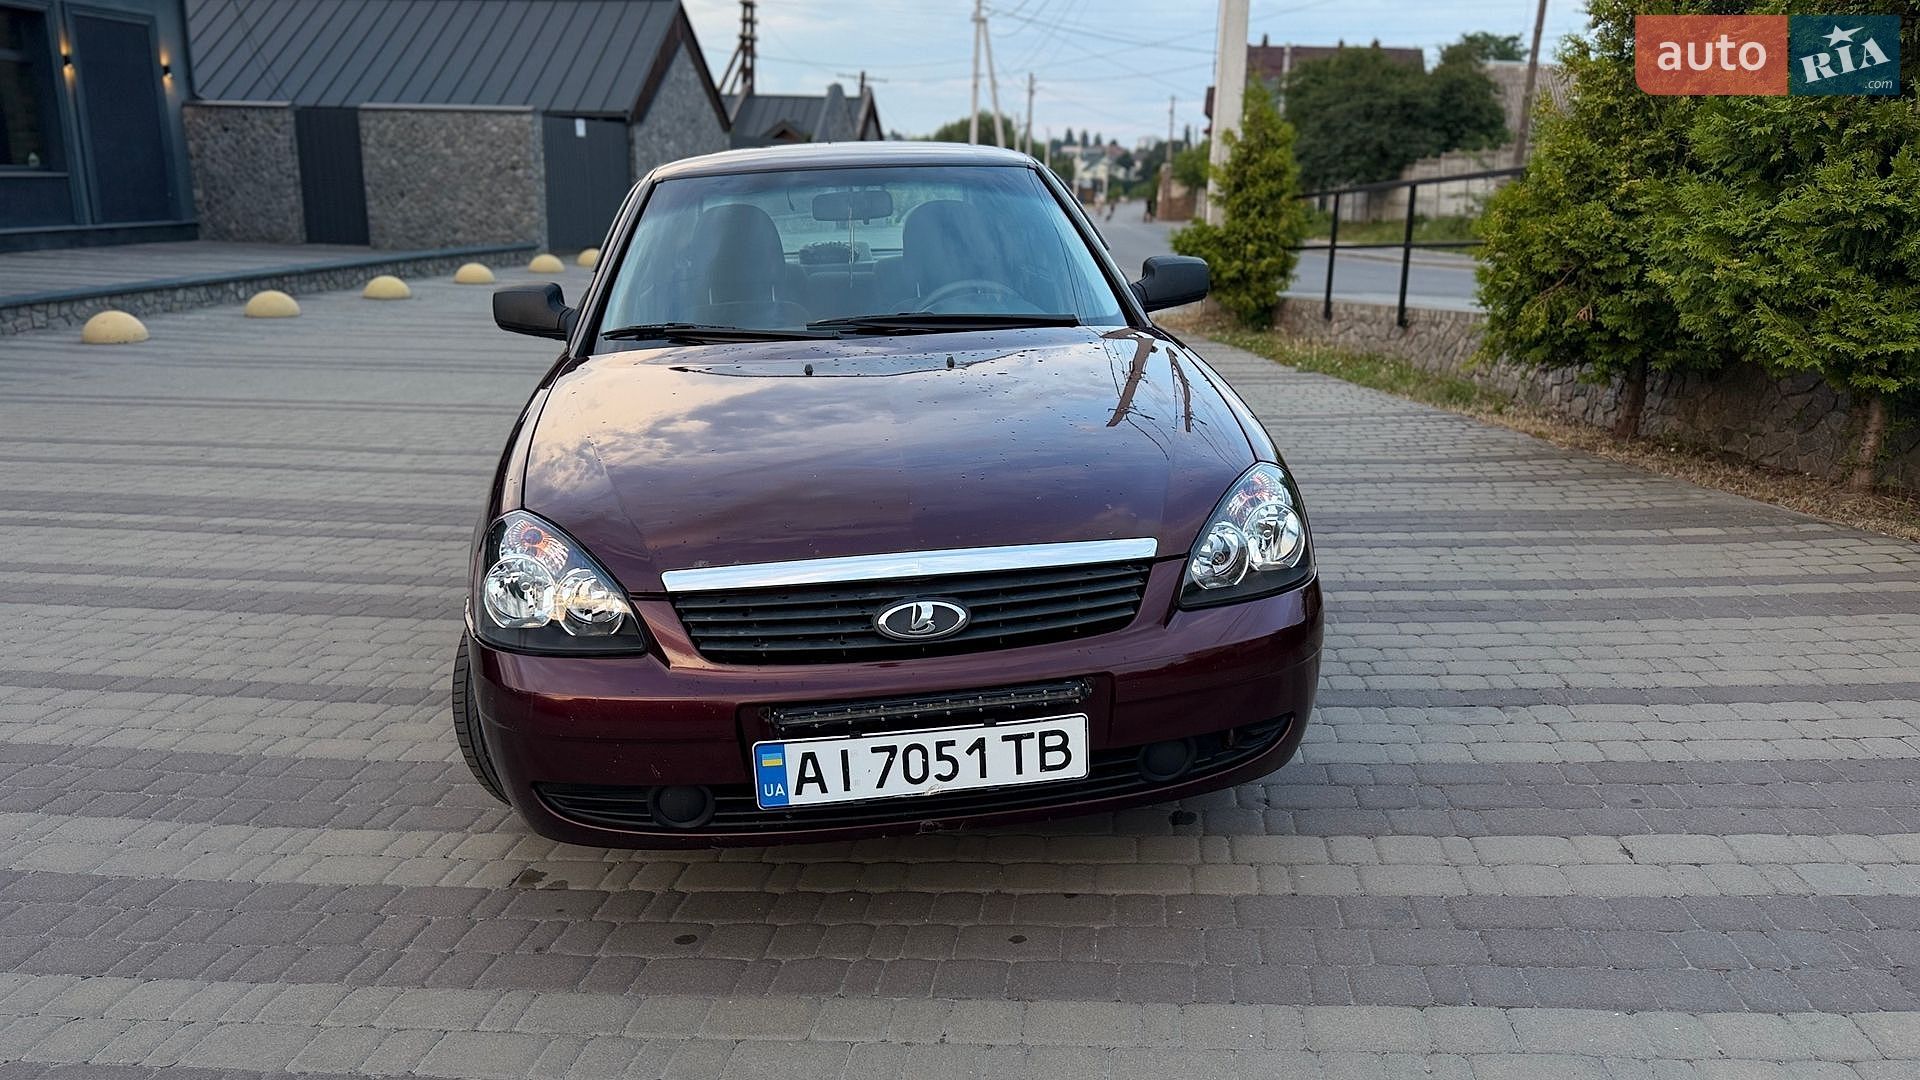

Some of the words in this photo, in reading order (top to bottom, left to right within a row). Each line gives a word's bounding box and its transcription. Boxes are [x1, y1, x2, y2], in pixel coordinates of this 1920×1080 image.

[794, 749, 852, 796] AI
[870, 737, 988, 789] 7051
[1001, 728, 1073, 776] TB
[763, 782, 786, 797] UA
